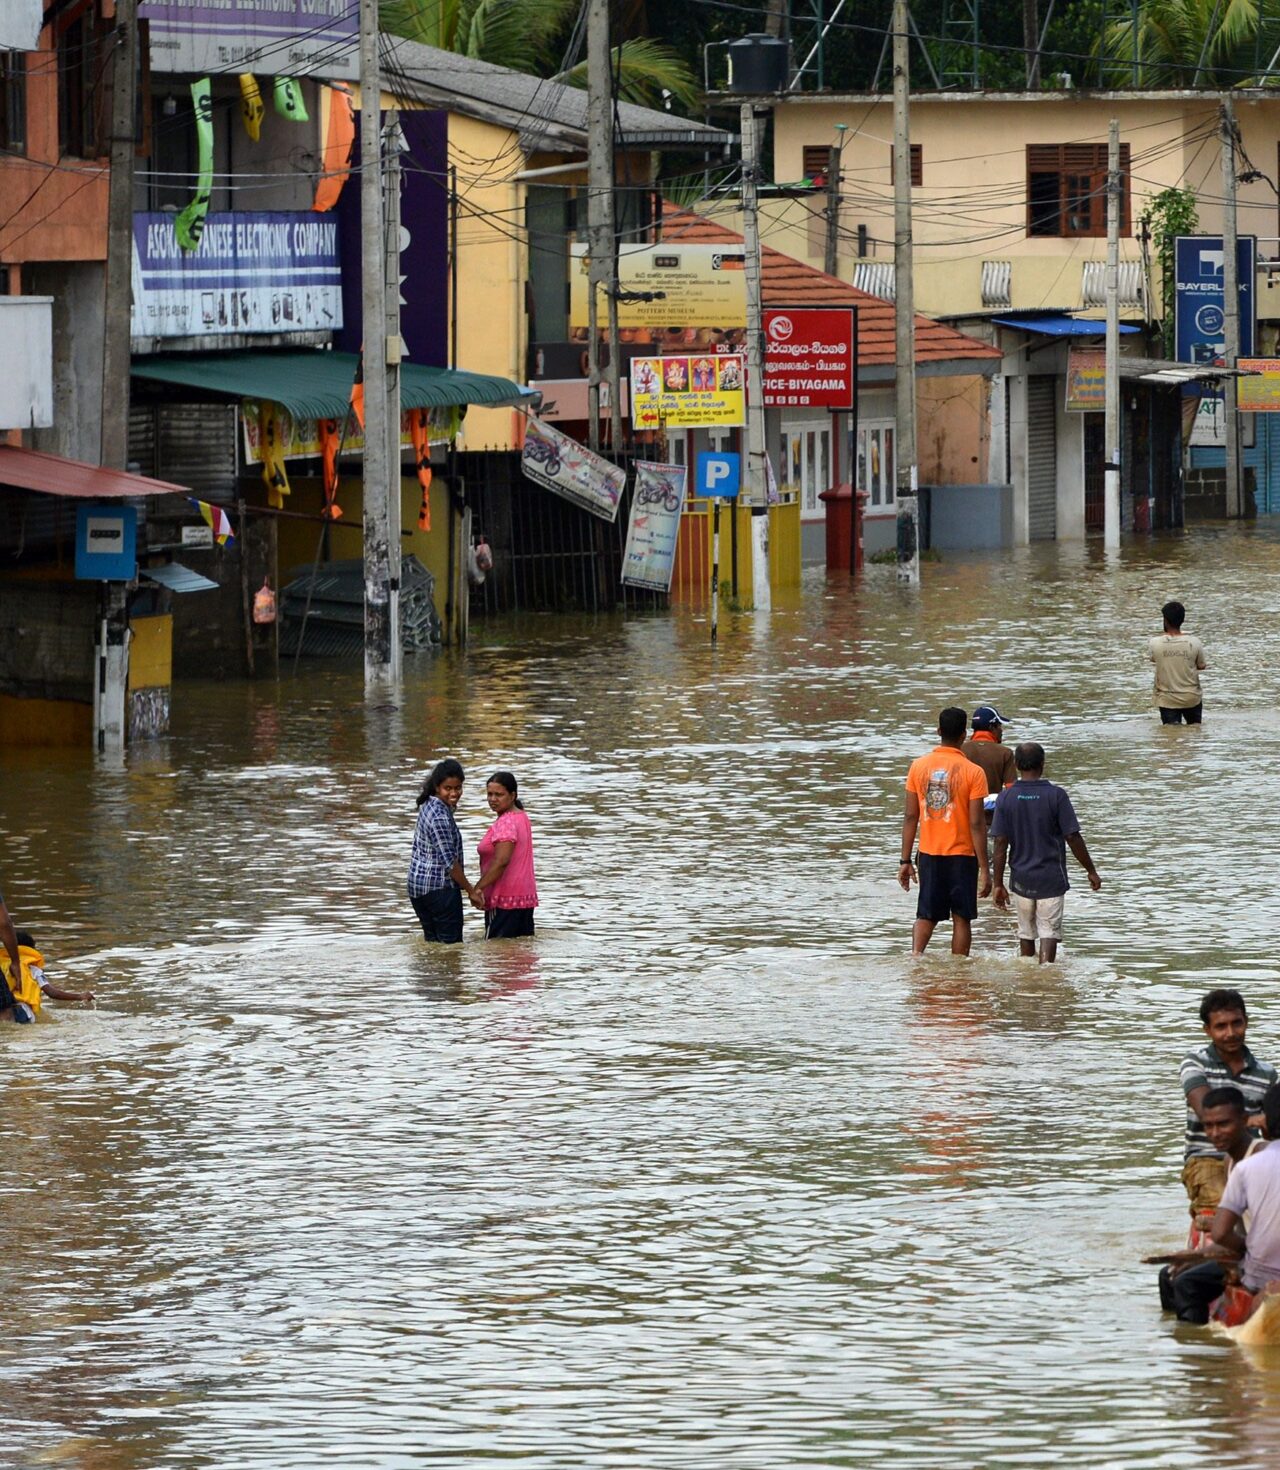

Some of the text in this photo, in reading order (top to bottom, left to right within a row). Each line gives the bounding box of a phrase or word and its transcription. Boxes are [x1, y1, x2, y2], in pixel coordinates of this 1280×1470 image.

[236, 223, 291, 257] ELECTRONIC
[293, 223, 337, 257] COMPANY
[1177, 282, 1248, 292] SAYERLK
[706, 461, 730, 488] P
